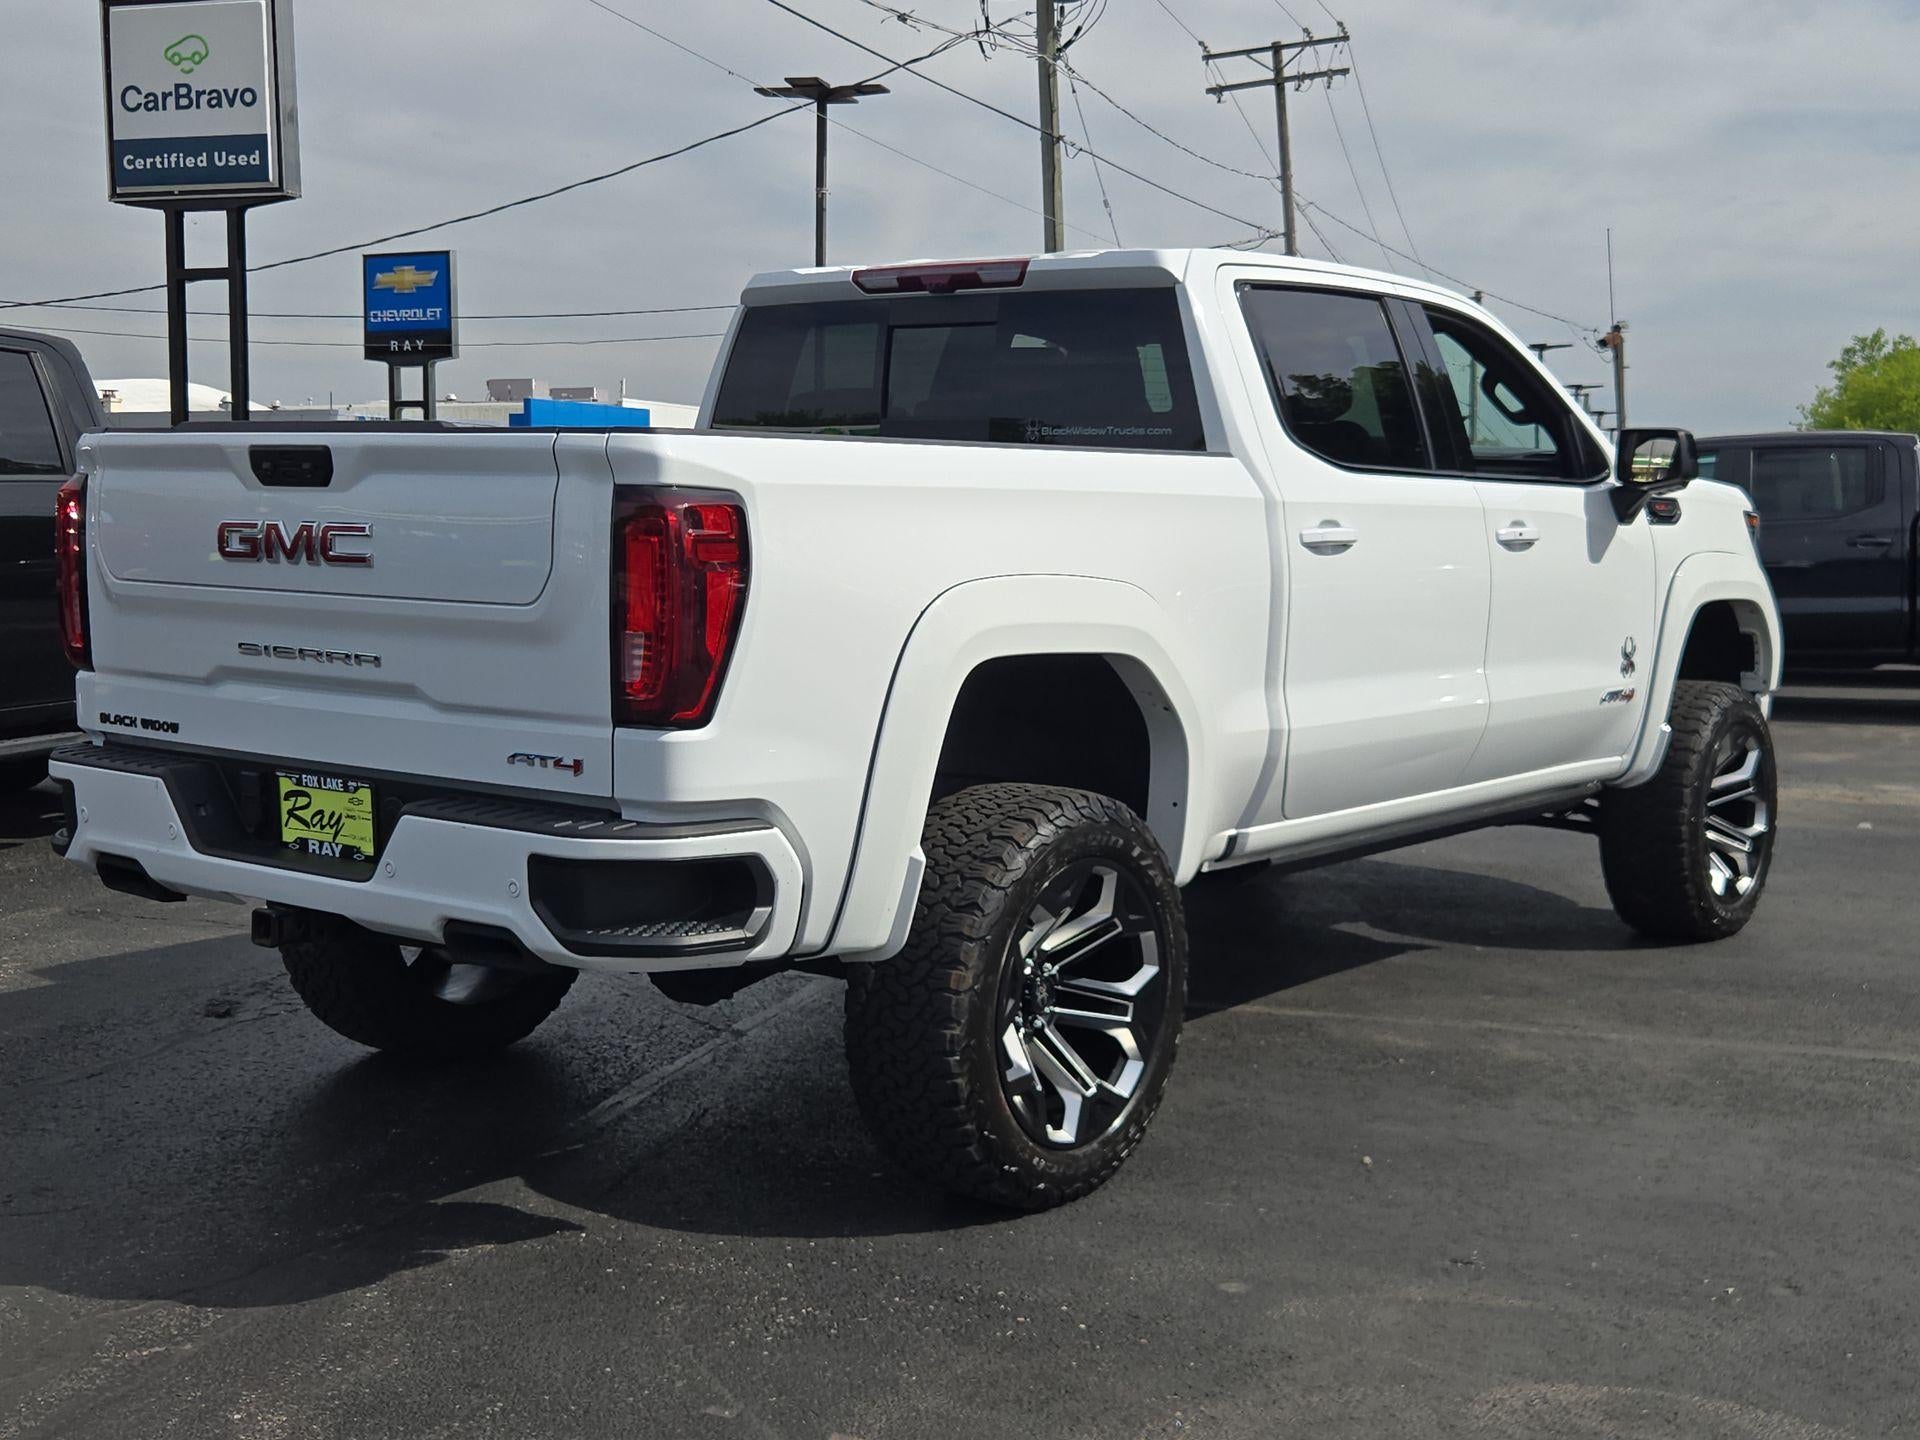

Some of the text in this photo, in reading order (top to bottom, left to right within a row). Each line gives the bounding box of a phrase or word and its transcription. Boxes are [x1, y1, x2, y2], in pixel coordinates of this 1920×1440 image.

[121, 83, 257, 112] CarBravo
[123, 150, 260, 170] Certified Used
[370, 308, 442, 322] CHEVROLET
[390, 340, 424, 352] RAY
[1041, 426, 1172, 436] BlackWidowTrucks.com
[217, 519, 374, 568] GMC
[238, 642, 382, 668] SIERRA
[100, 712, 180, 734] BLACK WIDOW
[507, 752, 584, 777] AT4
[301, 774, 319, 788] FOX
[320, 776, 344, 791] LAKE
[283, 789, 345, 843] Ray
[308, 839, 343, 858] RAY
